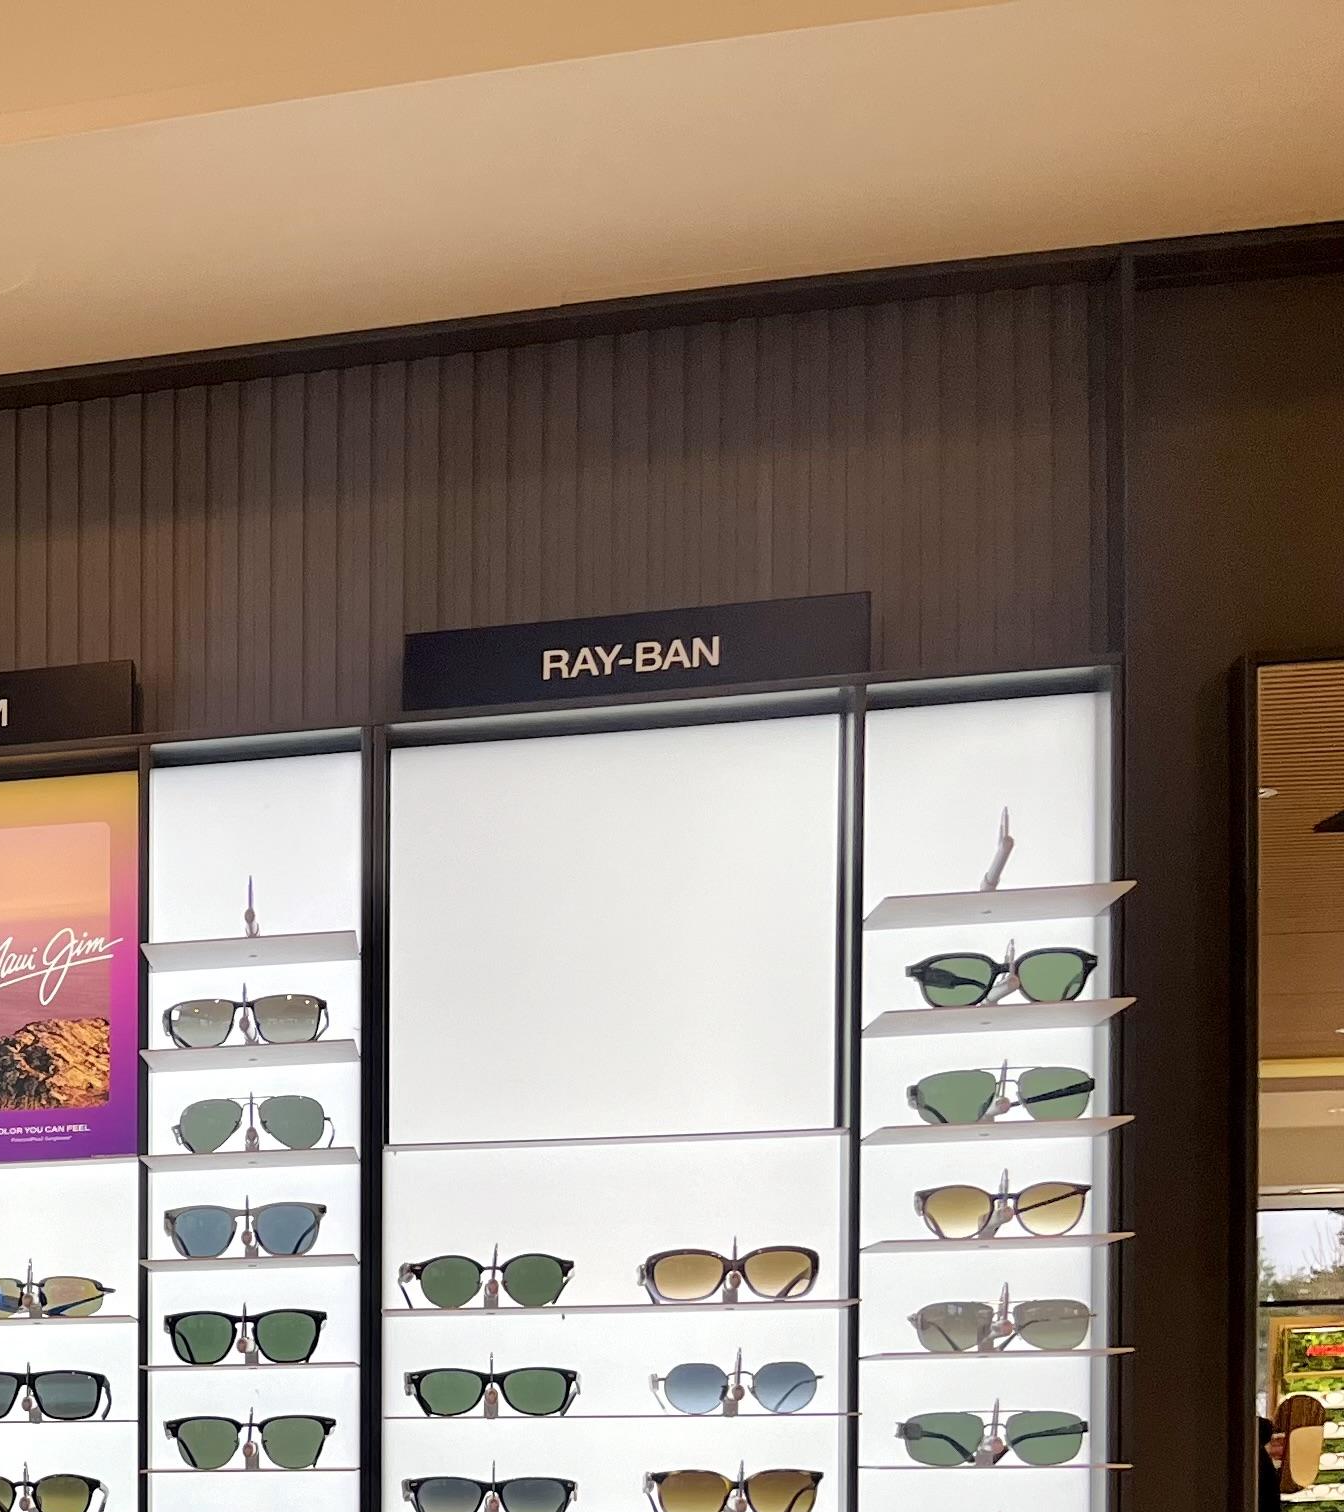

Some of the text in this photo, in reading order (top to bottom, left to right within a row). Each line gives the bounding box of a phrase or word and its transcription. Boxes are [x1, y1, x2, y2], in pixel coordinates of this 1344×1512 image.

[541, 635, 720, 681] RAY-BAN
[39, 927, 124, 1006] Jim
[24, 1125, 43, 1135] YOU
[44, 1124, 65, 1134] CAN
[66, 1123, 91, 1133] FEEL
